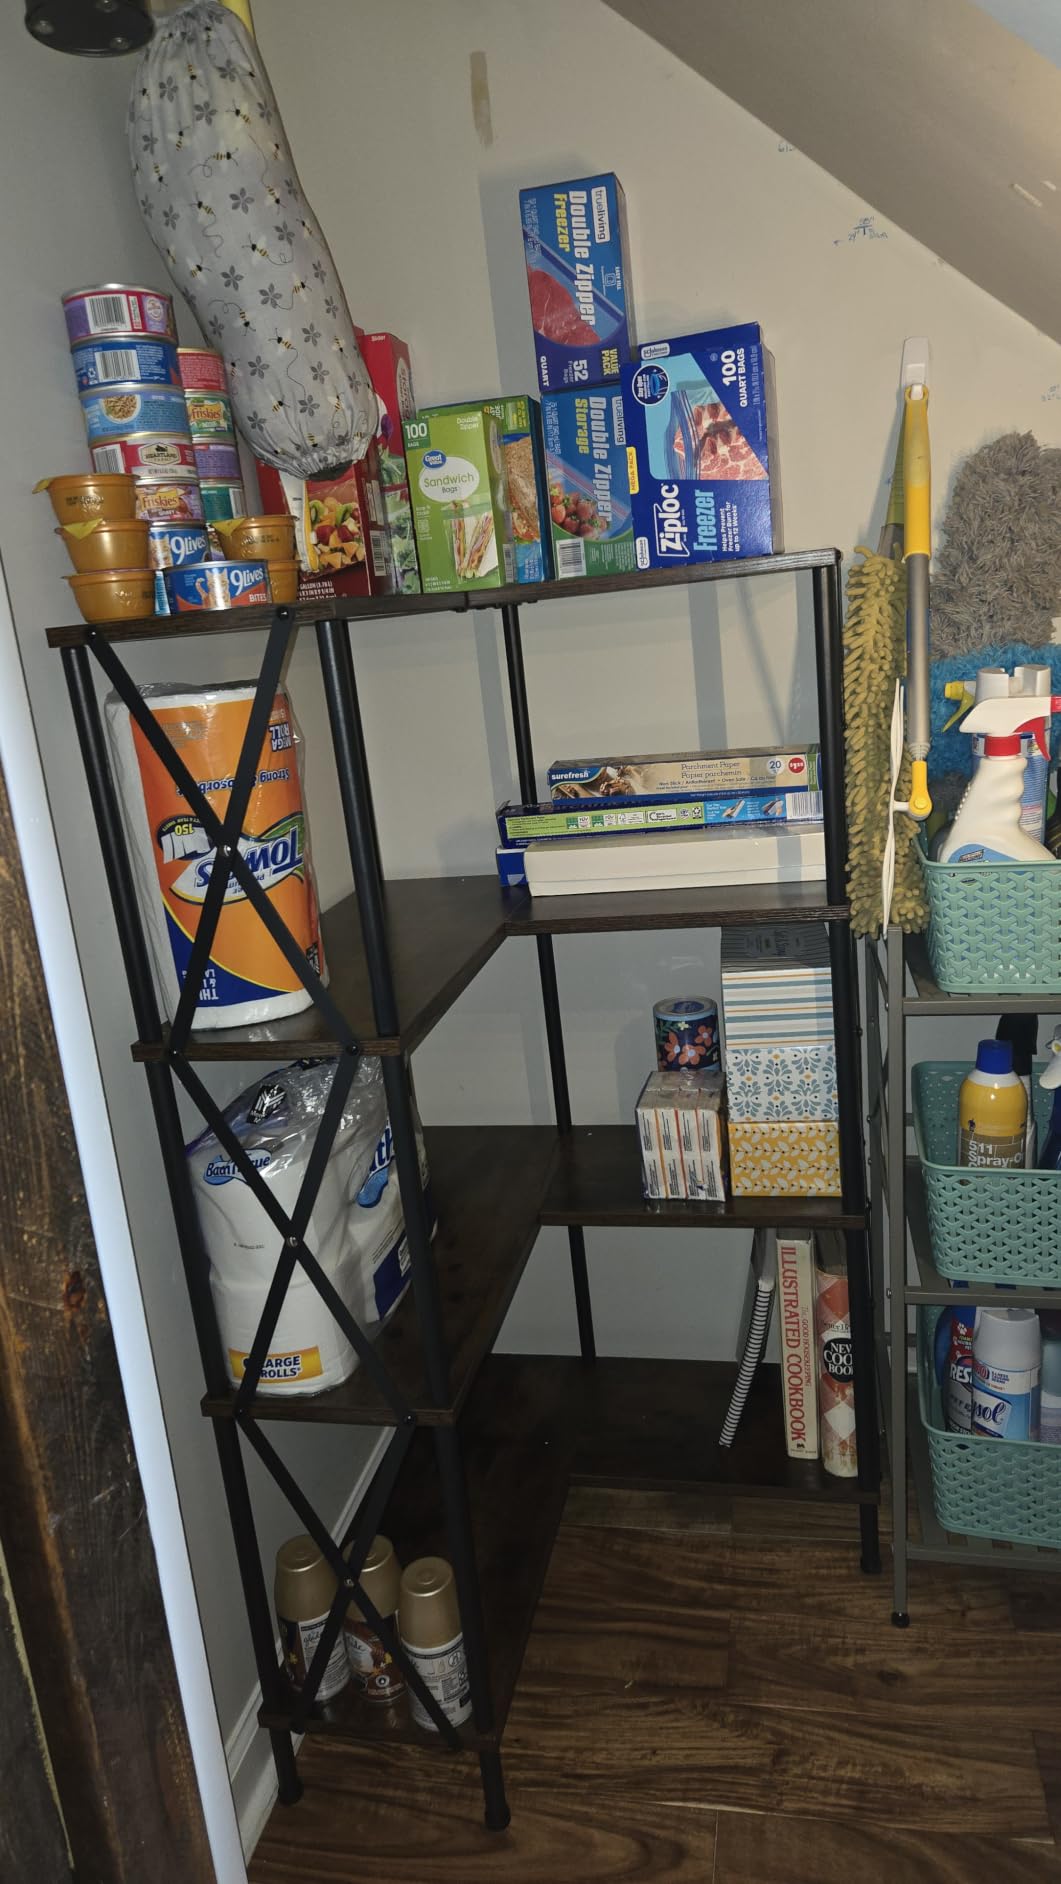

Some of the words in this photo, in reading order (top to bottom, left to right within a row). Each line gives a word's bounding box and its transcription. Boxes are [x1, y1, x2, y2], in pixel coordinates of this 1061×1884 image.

[553, 193, 571, 252] Freezer
[568, 190, 592, 259] Double
[594, 190, 607, 240] trueliving
[574, 263, 597, 326] Zipper
[540, 355, 550, 387] QUART
[573, 359, 589, 381] 52
[601, 349, 612, 376] PACK
[608, 348, 620, 375] VALUE
[720, 349, 738, 387] 100
[736, 347, 746, 375] BAGS
[737, 375, 748, 408] QUART
[191, 408, 221, 421] Friskies
[575, 398, 590, 455] Storage
[404, 422, 428, 440] 100
[588, 396, 610, 460] Double
[424, 453, 442, 462] Great
[423, 472, 475, 489] Sandwich
[441, 486, 458, 494] Bags
[591, 463, 613, 522] Zipper
[142, 495, 178, 508] Friskies
[657, 483, 689, 553] Ziploc
[693, 489, 718, 551] Freezer
[719, 508, 727, 530] Prevent
[170, 534, 207, 565] 9Lives
[230, 566, 264, 596] 9Lives
[248, 593, 267, 602] BITES
[260, 768, 289, 783] Strong
[551, 769, 590, 780] surefresh
[681, 761, 719, 771] Parchment
[719, 760, 740, 769] Paper
[681, 771, 704, 780] Papier
[704, 770, 742, 779] parchemin
[768, 760, 782, 770] 20
[174, 823, 195, 837] 150
[968, 1140, 993, 1155] 511
[780, 1246, 802, 1349] ILLUSTRATED
[262, 1355, 301, 1369] ARGE
[823, 1350, 853, 1366] COO
[828, 1363, 854, 1376] BOO
[786, 1353, 806, 1442] COOKBOOK
